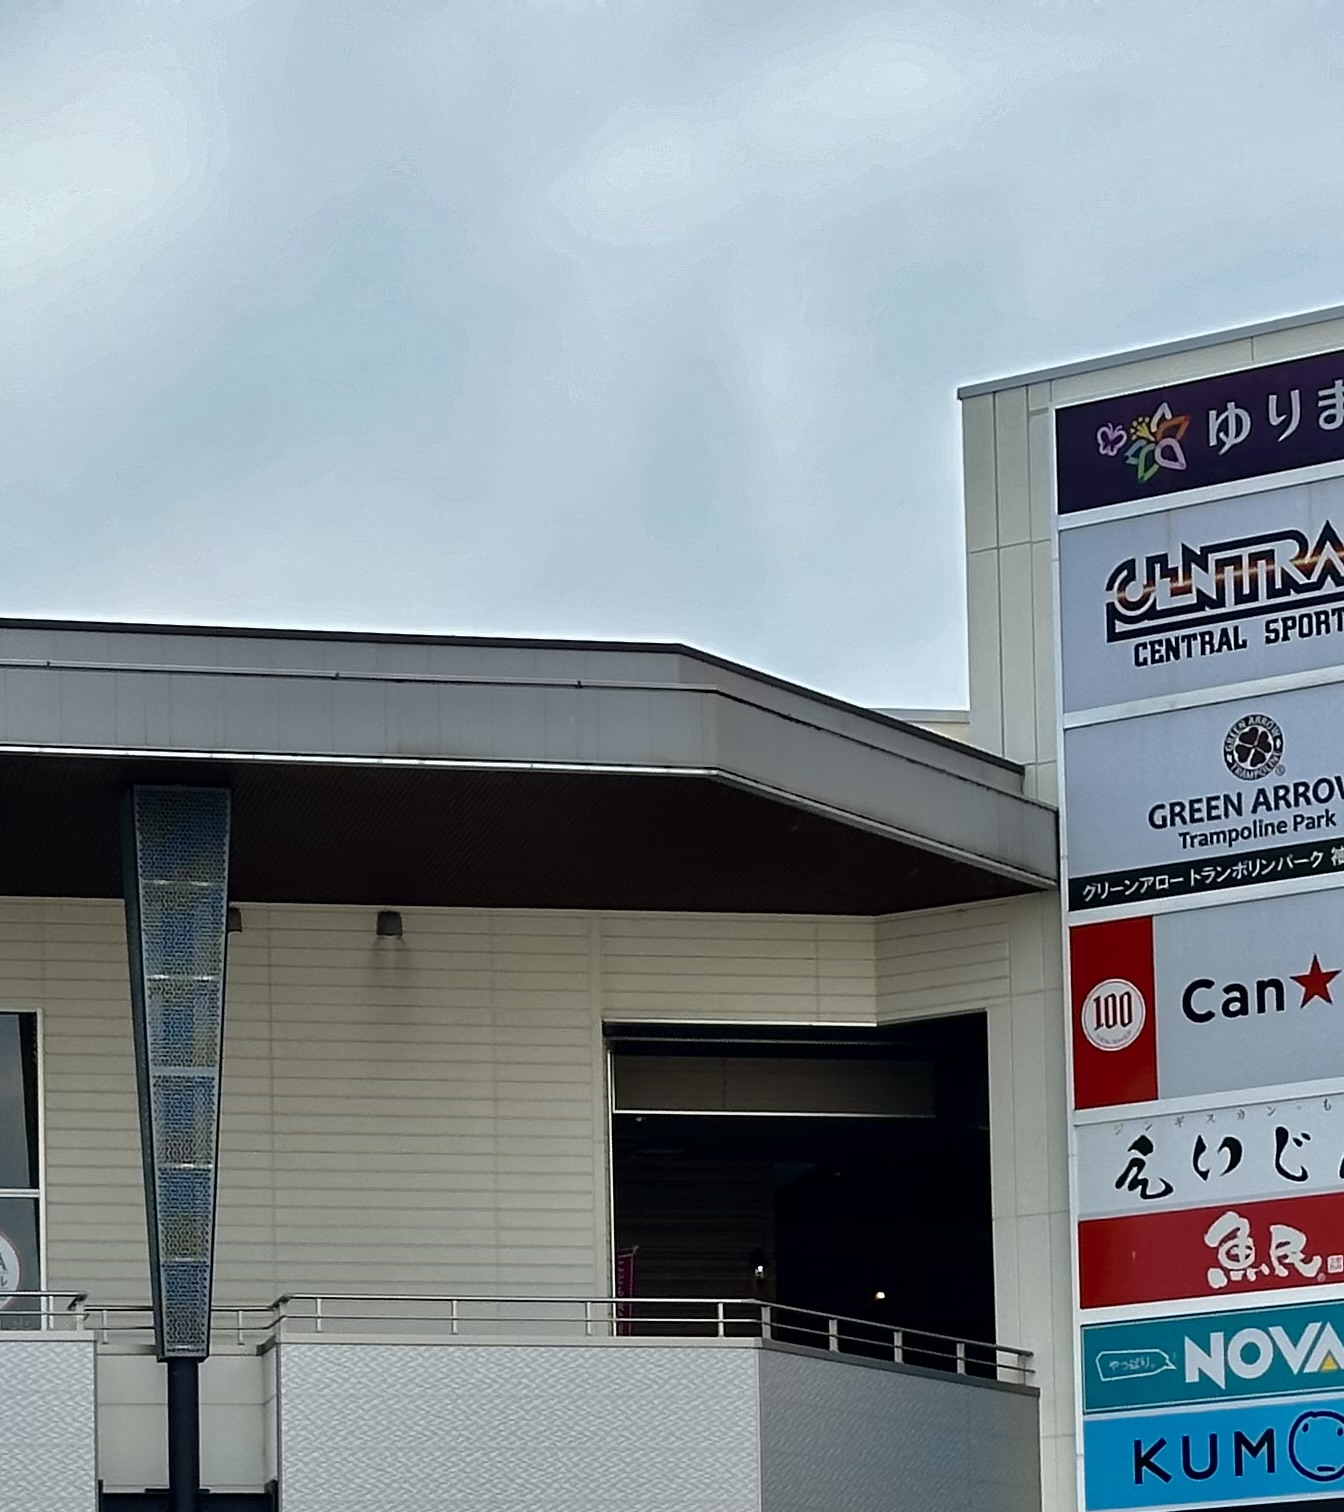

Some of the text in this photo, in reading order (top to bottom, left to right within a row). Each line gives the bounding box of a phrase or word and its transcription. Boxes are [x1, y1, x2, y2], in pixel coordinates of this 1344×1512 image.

[1134, 625, 1248, 667] CENTRAL
[1148, 792, 1243, 829] GREEN
[1179, 809, 1337, 851] Trampoline Park
[1093, 991, 1133, 1031] 100
[1204, 1211, 1322, 1289] 魚民
